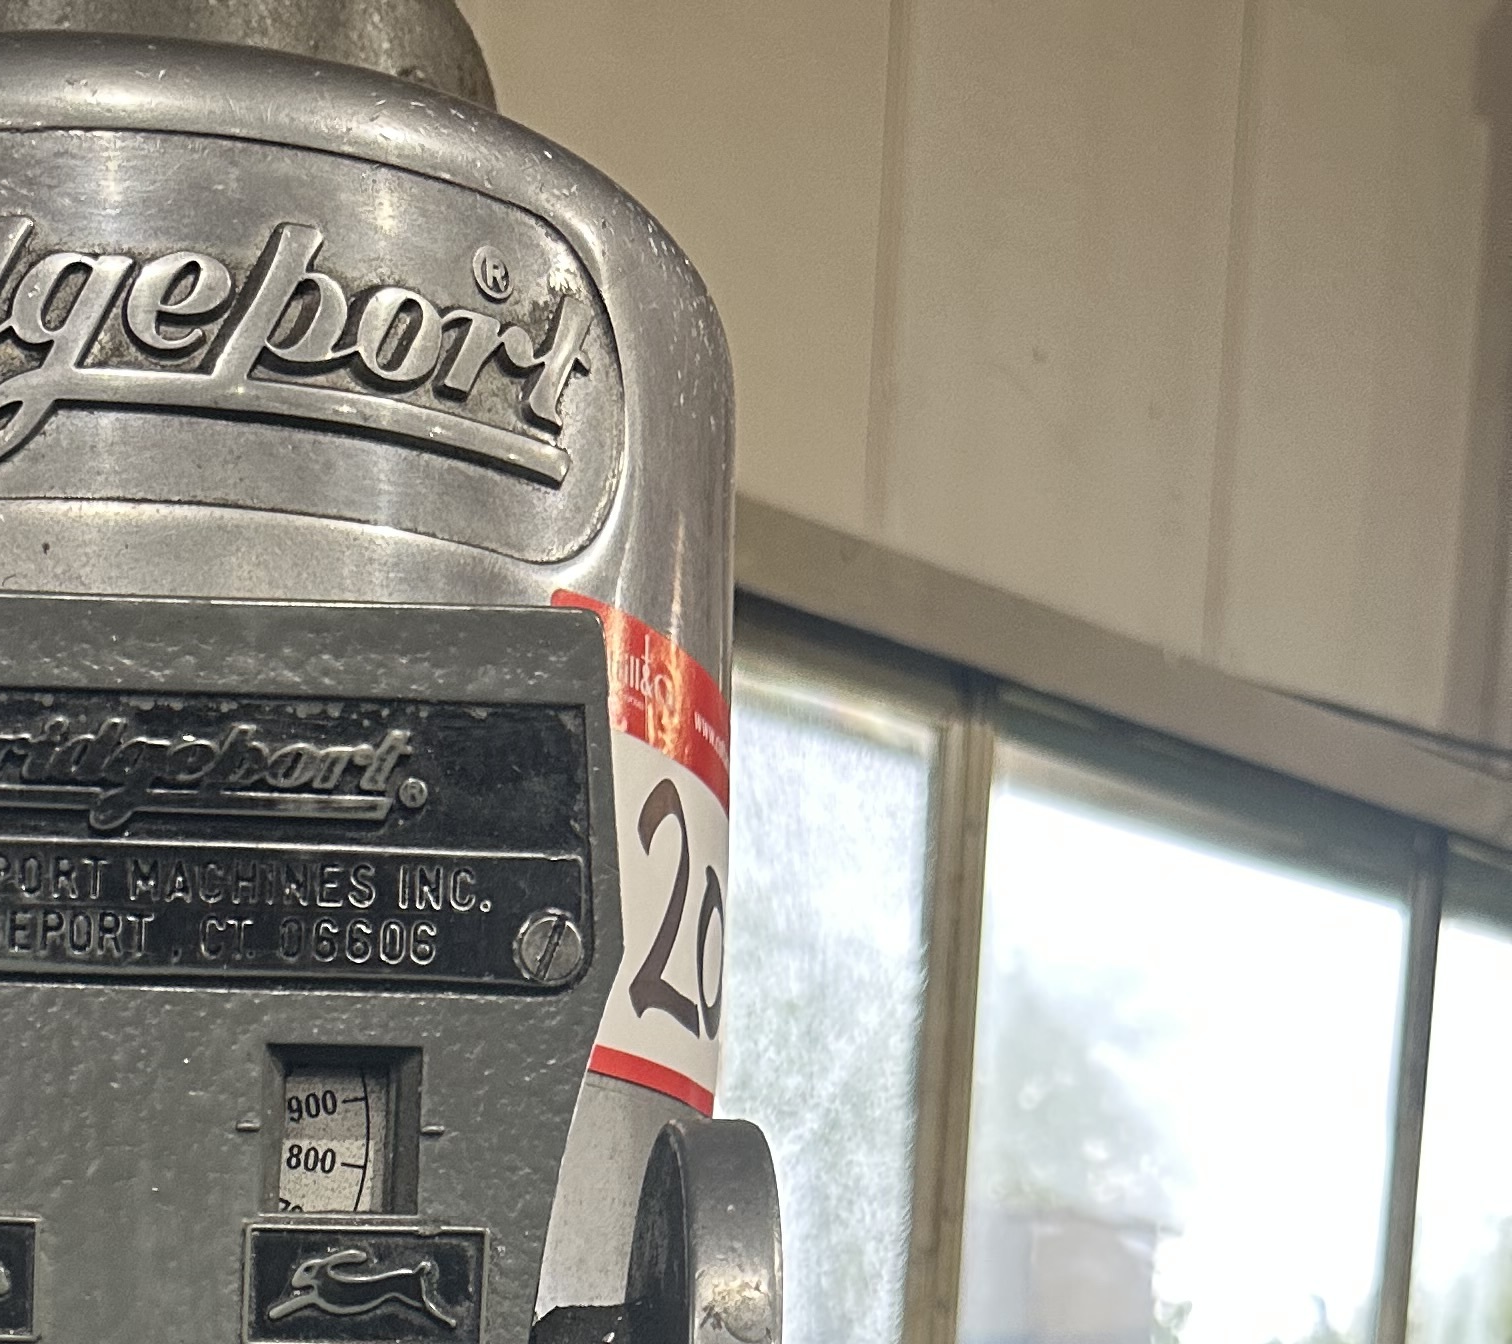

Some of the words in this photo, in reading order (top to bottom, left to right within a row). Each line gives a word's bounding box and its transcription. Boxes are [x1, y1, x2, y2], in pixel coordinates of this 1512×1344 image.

[126, 857, 377, 908] MACHINES
[397, 864, 492, 914] INC.
[280, 919, 438, 966] 06606
[287, 1089, 338, 1124] 900
[285, 1143, 337, 1174] 800
